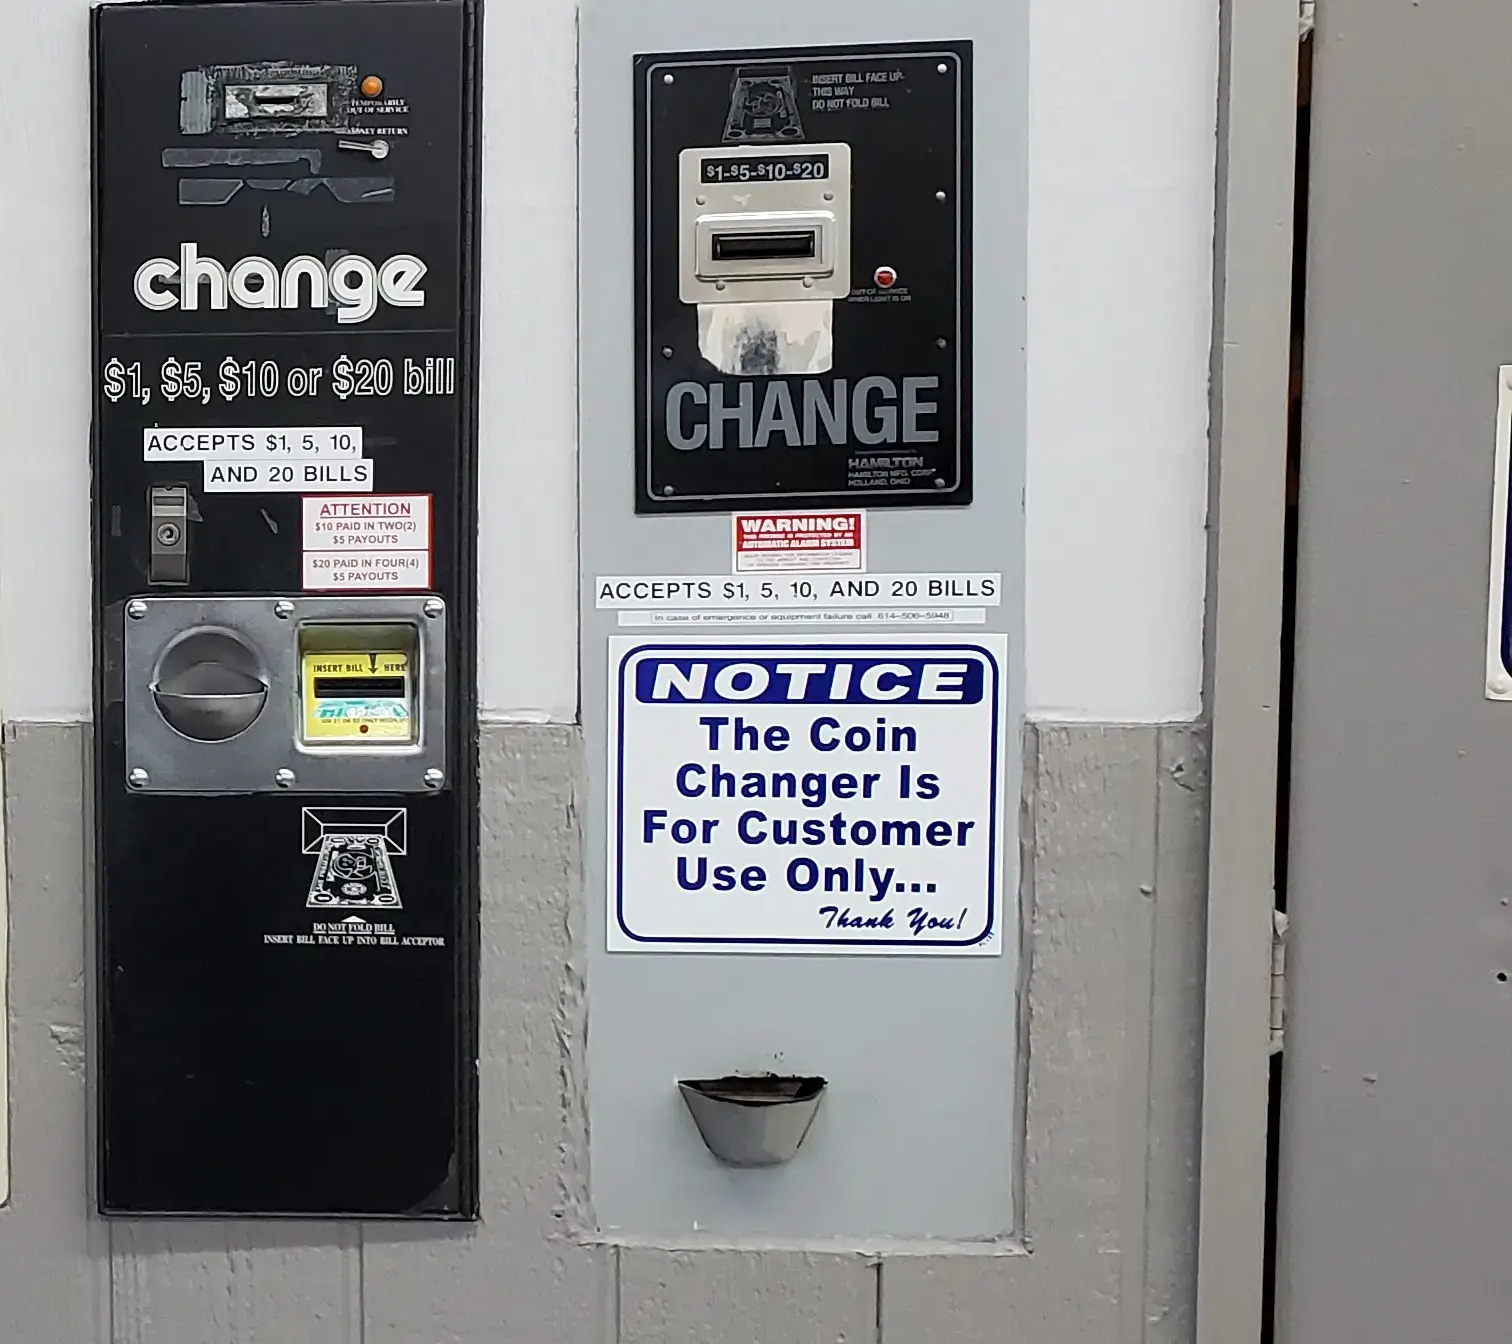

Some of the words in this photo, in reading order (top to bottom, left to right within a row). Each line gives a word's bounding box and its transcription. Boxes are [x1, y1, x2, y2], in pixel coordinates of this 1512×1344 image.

[134, 243, 427, 323] change
[104, 358, 150, 405] $1,
[161, 357, 210, 404] $5,
[219, 357, 278, 400] $10
[288, 368, 322, 396] or
[332, 355, 393, 399] $20
[404, 358, 454, 395] bill
[666, 376, 938, 454] CHANGE
[148, 434, 254, 451] ACCEPTS
[266, 434, 290, 453] $1,
[302, 434, 321, 455] 5,
[848, 457, 923, 469] HAMILTON
[211, 467, 257, 482] AND
[269, 467, 293, 482] 20
[305, 466, 367, 481] BILLS
[320, 503, 411, 515] ATTENTION
[315, 522, 332, 531] $10
[336, 522, 361, 530] PAID
[364, 522, 374, 530] IN
[378, 521, 416, 532] TWO(2)
[741, 518, 855, 532] WARNING!
[333, 536, 345, 544] $5
[348, 535, 398, 544] PAYOUTS
[312, 559, 330, 568] $20
[334, 559, 358, 567] PAID
[362, 559, 371, 567] IN
[375, 558, 419, 568] FOUR(4)
[333, 573, 345, 581] $5
[348, 572, 398, 580] PAYOUTS
[600, 582, 711, 599] ACCEPTS
[723, 583, 749, 601] $1,
[761, 583, 778, 599] 5,
[791, 582, 817, 600] 10,
[830, 581, 879, 596] AND
[892, 581, 917, 596] 20
[929, 580, 994, 596] BILLS
[346, 664, 363, 672] BILL
[652, 664, 967, 700] NOTICE
[700, 717, 790, 751] The
[811, 717, 916, 751] Coin
[677, 763, 880, 807] Changer
[900, 765, 939, 799] Is
[644, 810, 719, 844] For
[738, 811, 975, 846] Customer
[677, 857, 766, 891] Use
[787, 858, 936, 901] Only...
[313, 923, 326, 931] DO
[328, 923, 347, 931] NOT
[348, 924, 372, 932] FOLD
[374, 924, 395, 932] BILL
[819, 906, 894, 929] Thank
[907, 908, 967, 936] You!
[264, 935, 293, 943] INSERT
[296, 935, 315, 944] BILL
[318, 936, 339, 944] FACE
[343, 936, 354, 944] UP
[357, 936, 377, 944] INTO
[380, 936, 399, 945] BILL
[401, 937, 445, 946] ACCEPTOR
